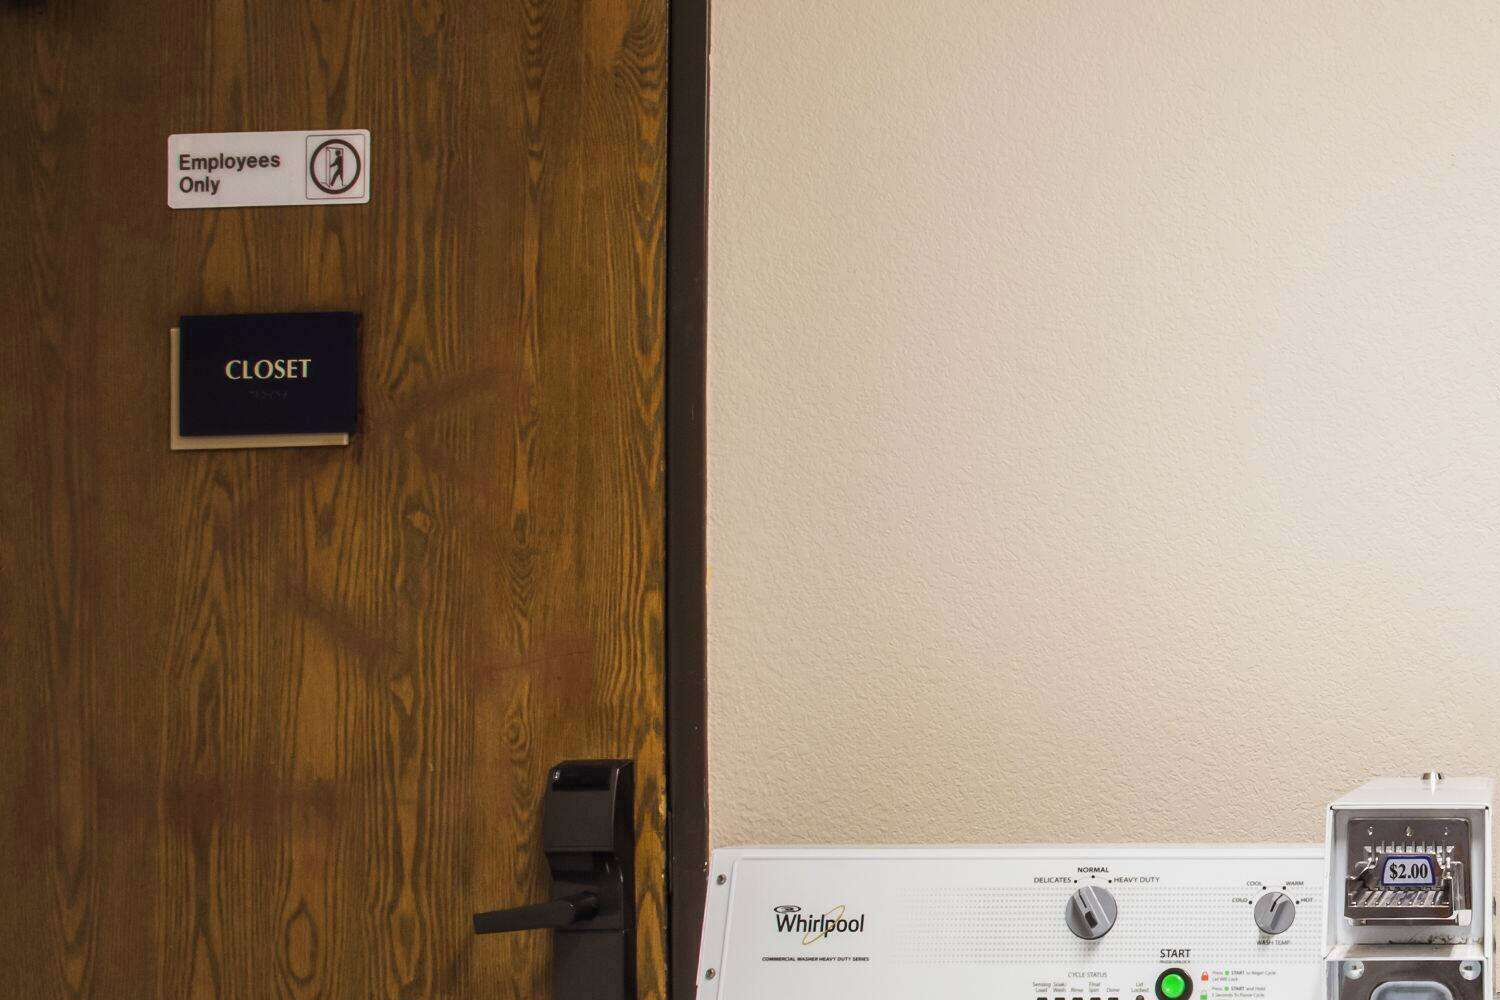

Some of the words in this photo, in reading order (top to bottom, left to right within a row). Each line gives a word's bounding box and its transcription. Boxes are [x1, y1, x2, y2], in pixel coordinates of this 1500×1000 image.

[179, 153, 281, 172] Employees
[179, 176, 220, 195] Only
[225, 359, 311, 380] CLOSET
[1389, 862, 1428, 881] $2.00
[776, 914, 864, 937] Whirlpool
[1160, 949, 1191, 958] START
